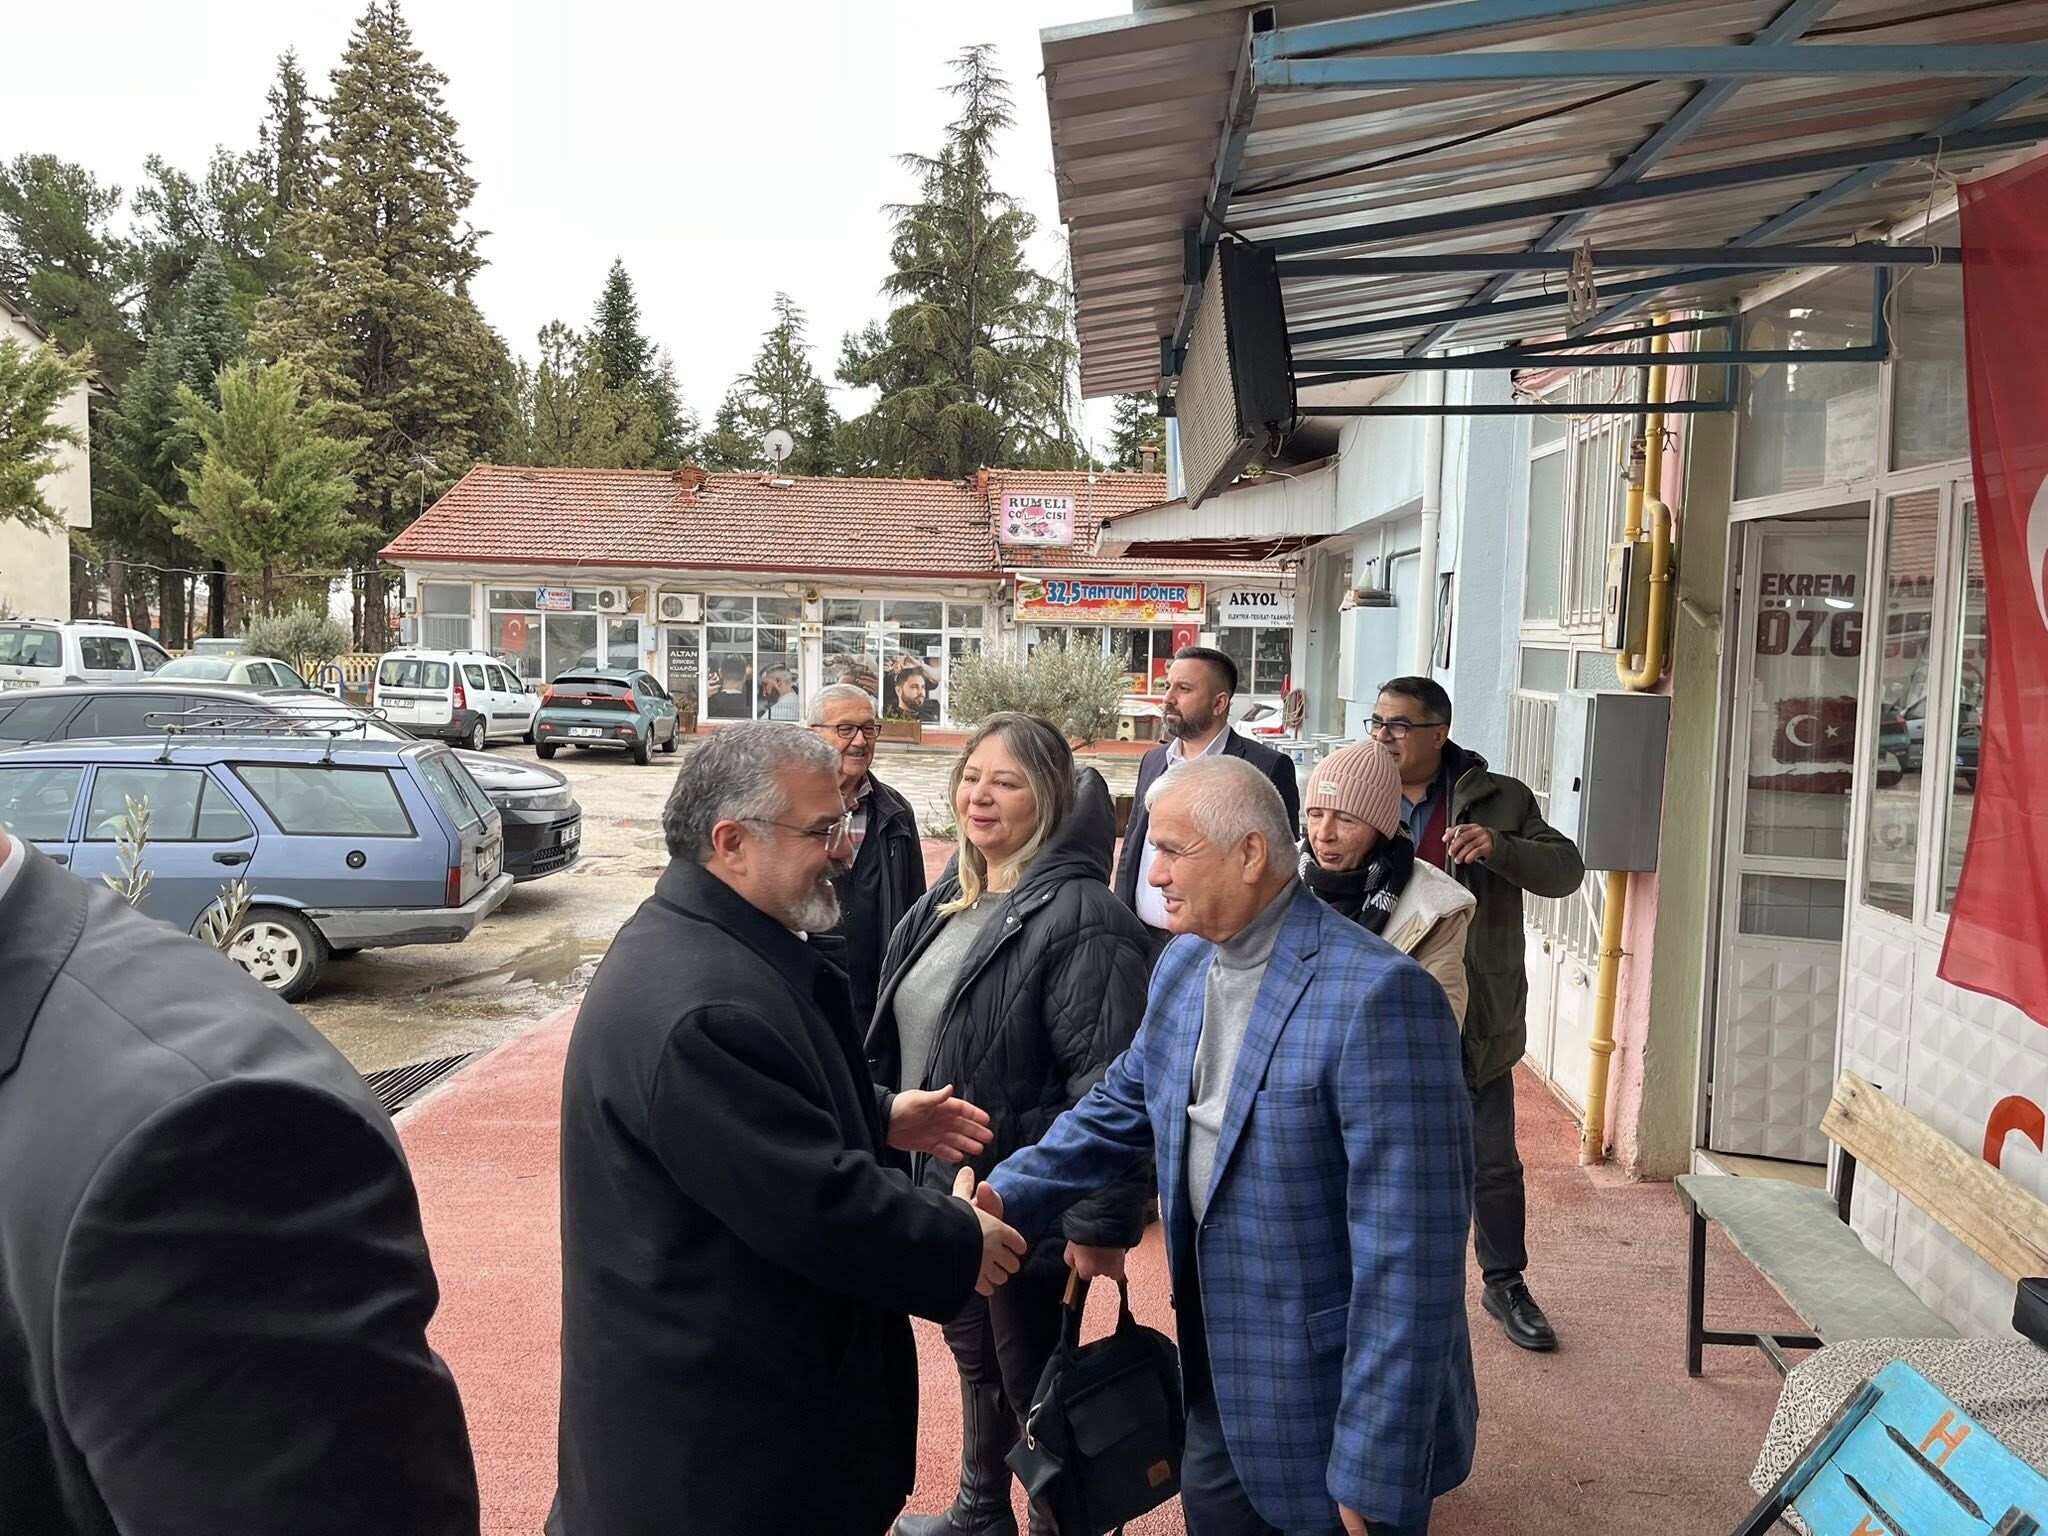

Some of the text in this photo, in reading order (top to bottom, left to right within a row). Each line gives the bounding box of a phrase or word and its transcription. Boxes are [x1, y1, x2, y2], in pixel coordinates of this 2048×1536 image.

[1046, 581, 1187, 606] 32,5 TANTUNİ DÖNER
[1760, 573, 1856, 597] EKREM
[1229, 592, 1279, 606] AKYOL
[1756, 599, 1864, 657] ÖZG
[669, 650, 698, 658] ALTAN
